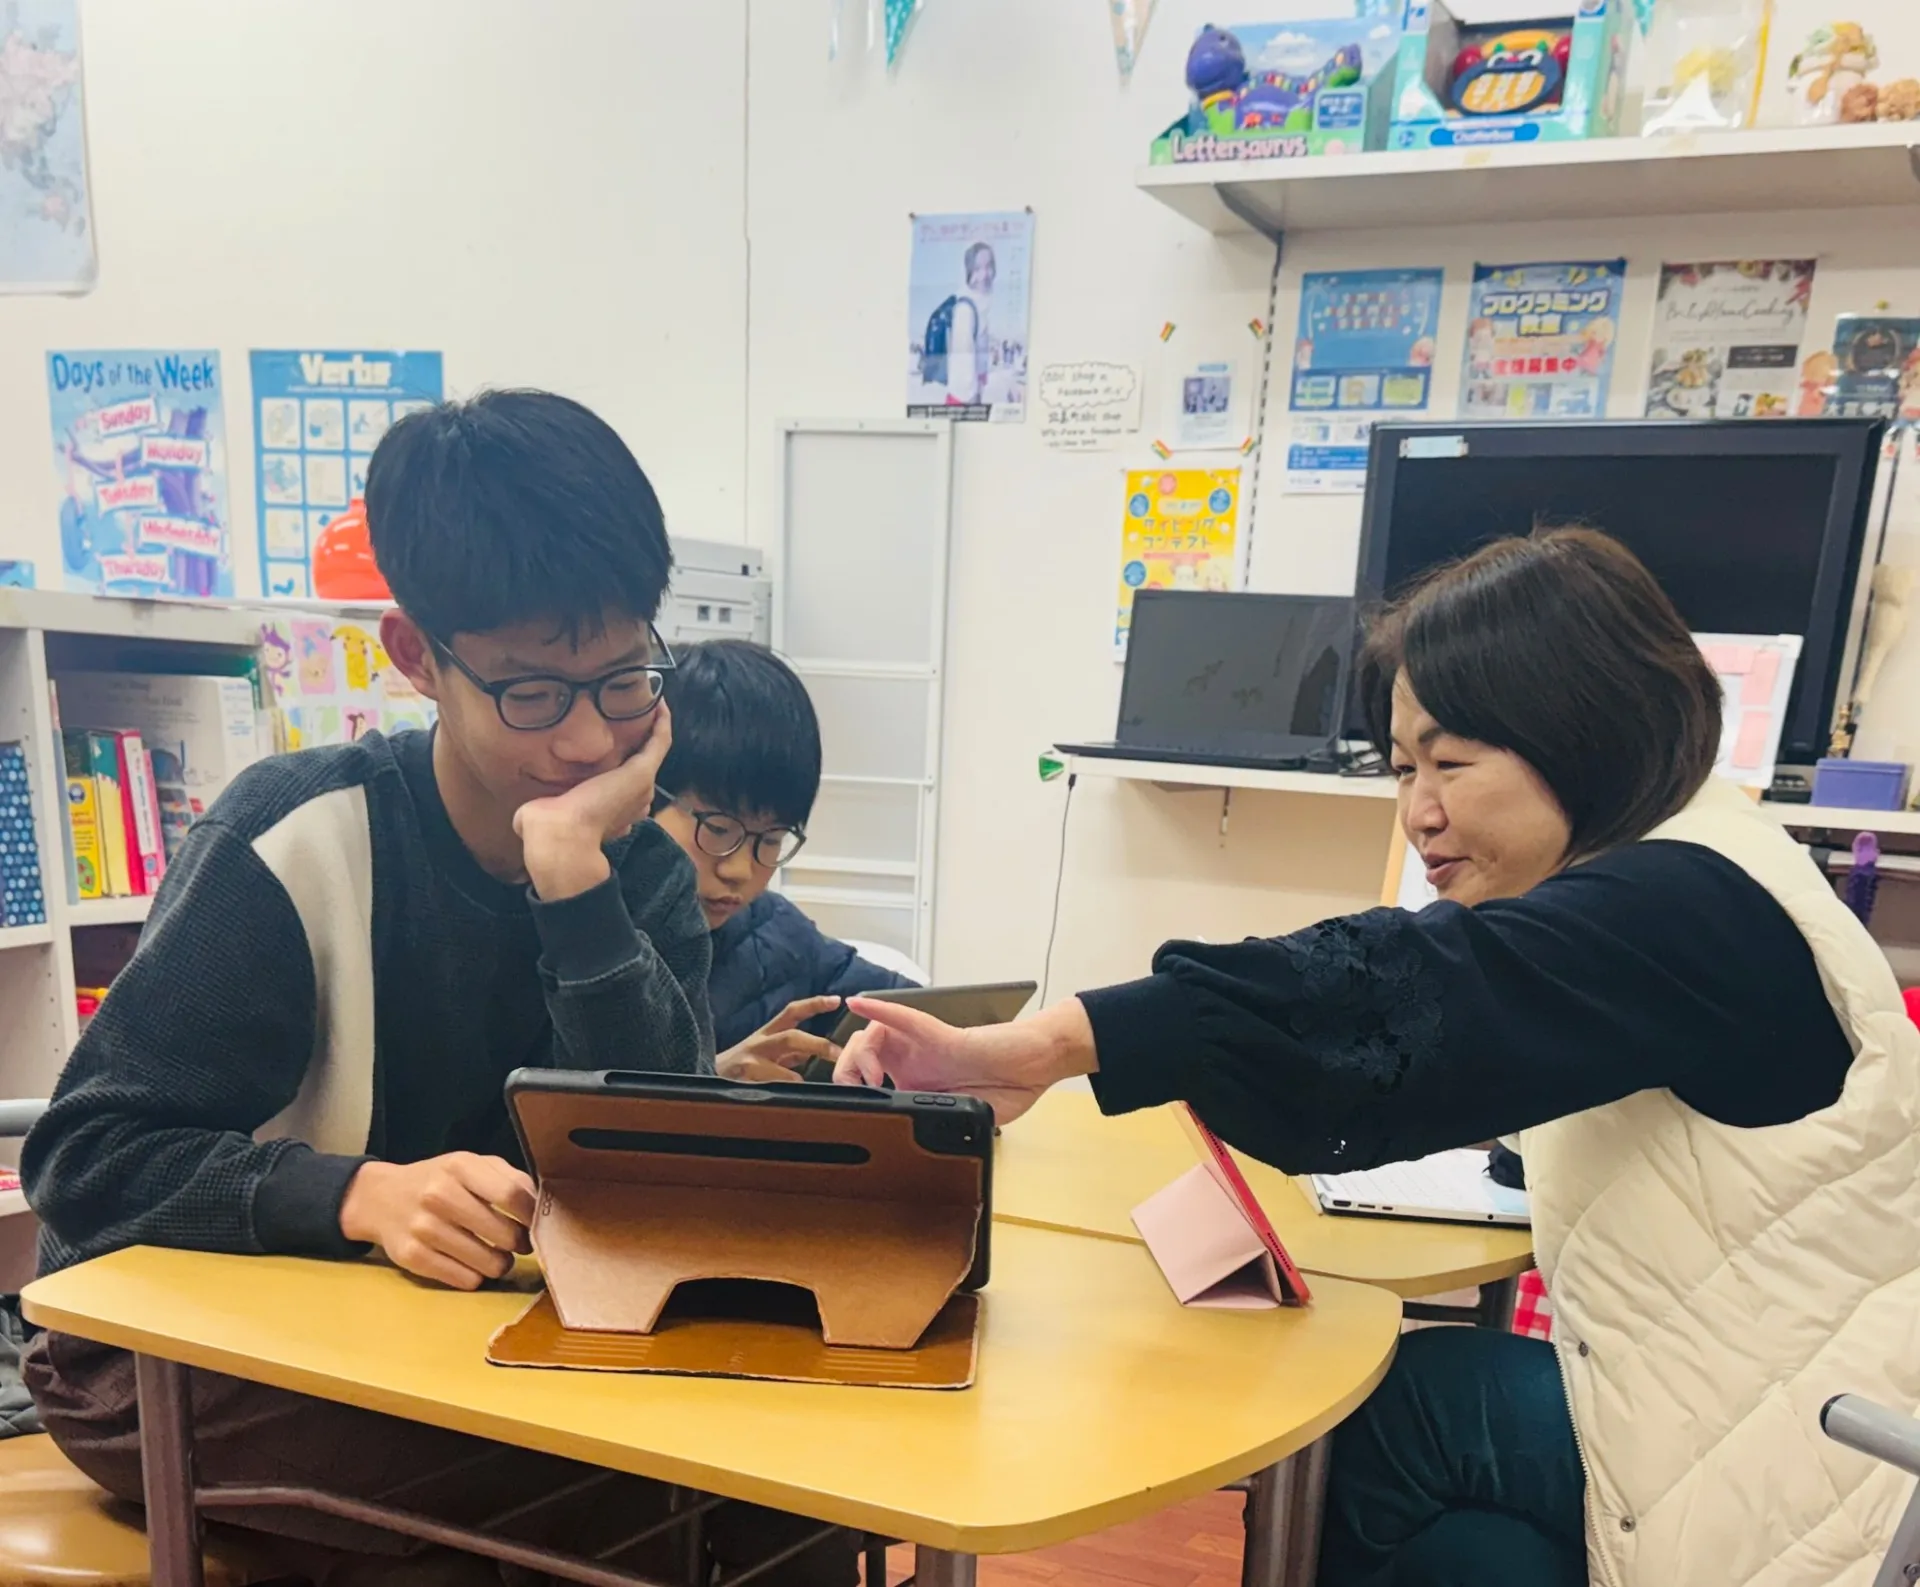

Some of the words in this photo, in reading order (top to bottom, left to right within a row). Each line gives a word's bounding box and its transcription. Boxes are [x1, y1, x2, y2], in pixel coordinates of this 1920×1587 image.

[1481, 289, 1610, 316] プログラミング
[51, 353, 104, 394] Days
[108, 362, 123, 386] of
[126, 362, 152, 386] the
[154, 354, 214, 392] Week
[101, 404, 152, 427] Sunday
[146, 442, 203, 464] Monday
